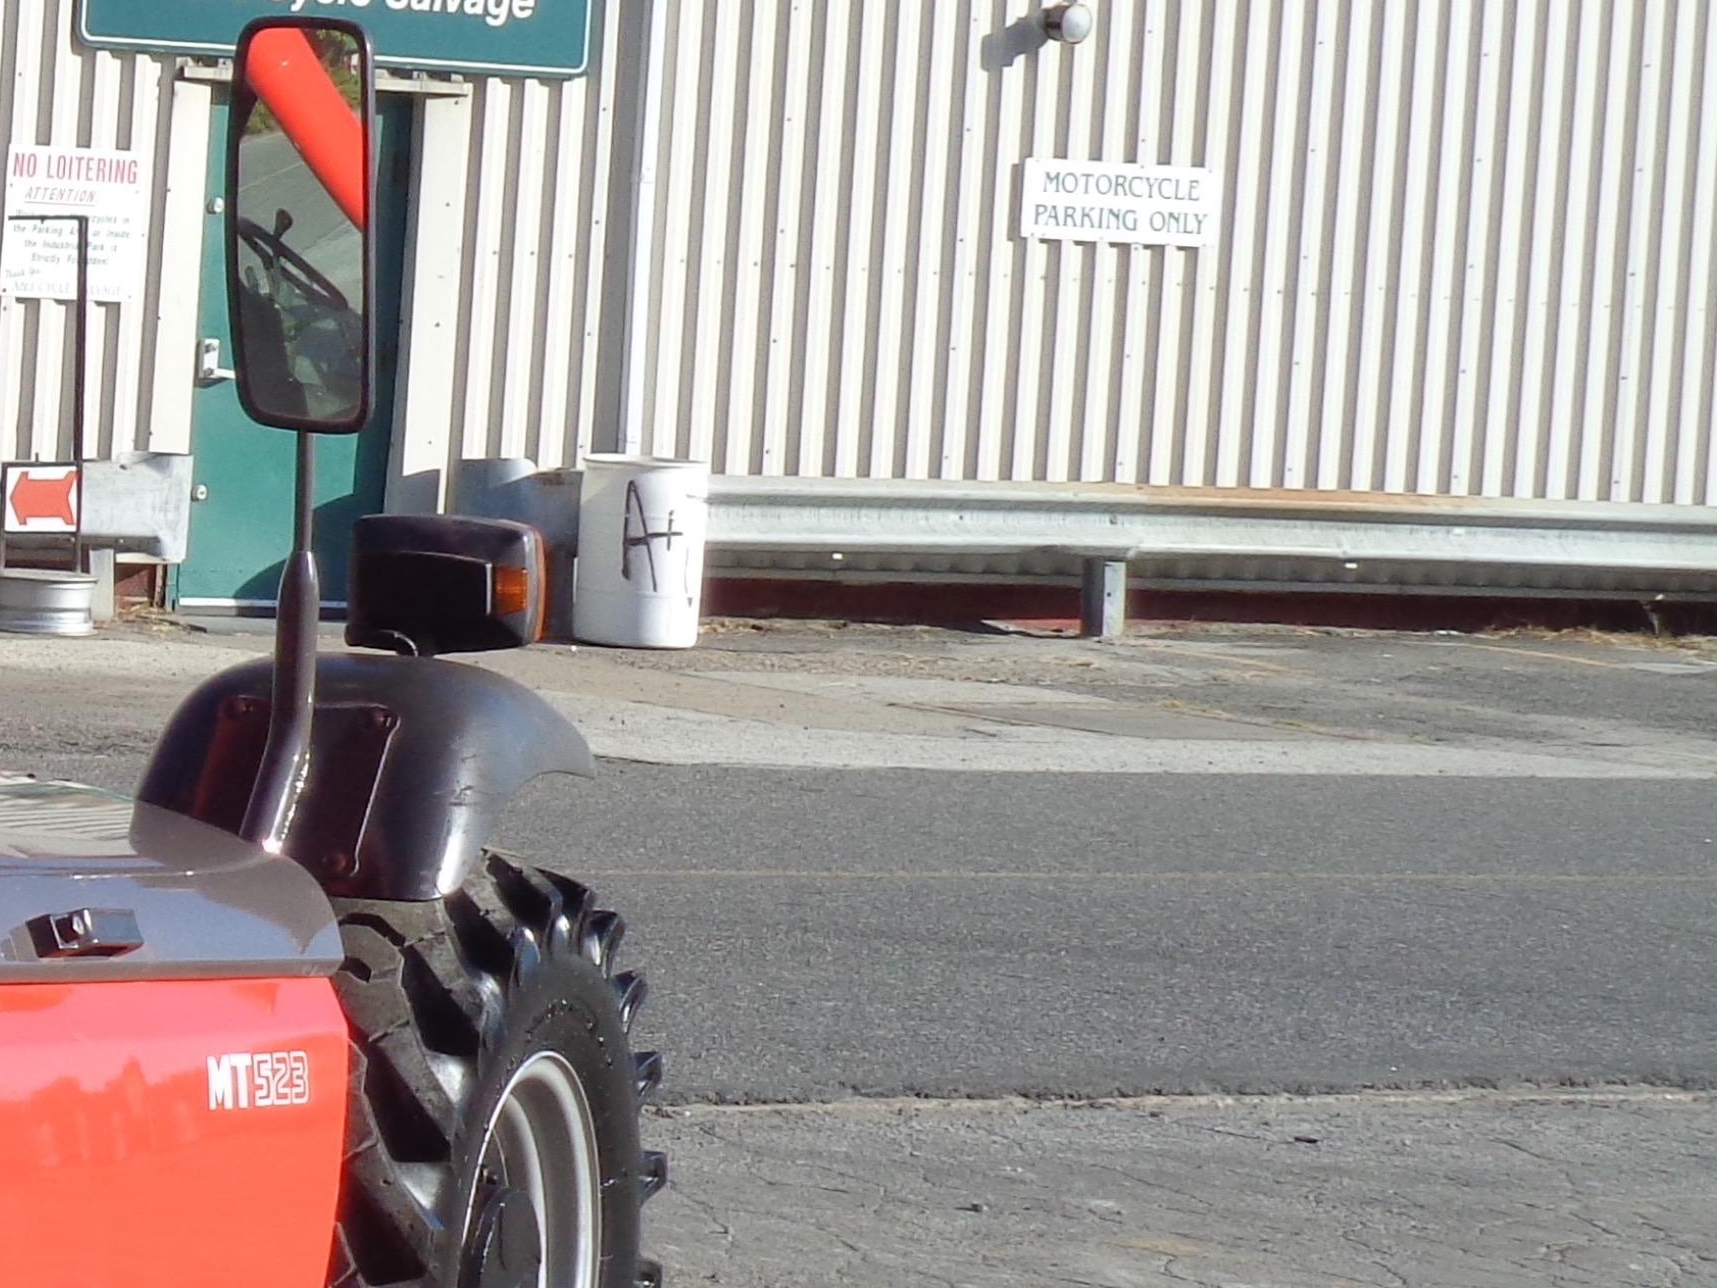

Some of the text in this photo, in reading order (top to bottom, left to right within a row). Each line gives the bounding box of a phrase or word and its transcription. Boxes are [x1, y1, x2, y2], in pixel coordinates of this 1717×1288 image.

[13, 152, 138, 184] NO LOITERING
[1043, 171, 1201, 201] MOTORCYCLE
[1034, 203, 1209, 235] PARKING ONLY
